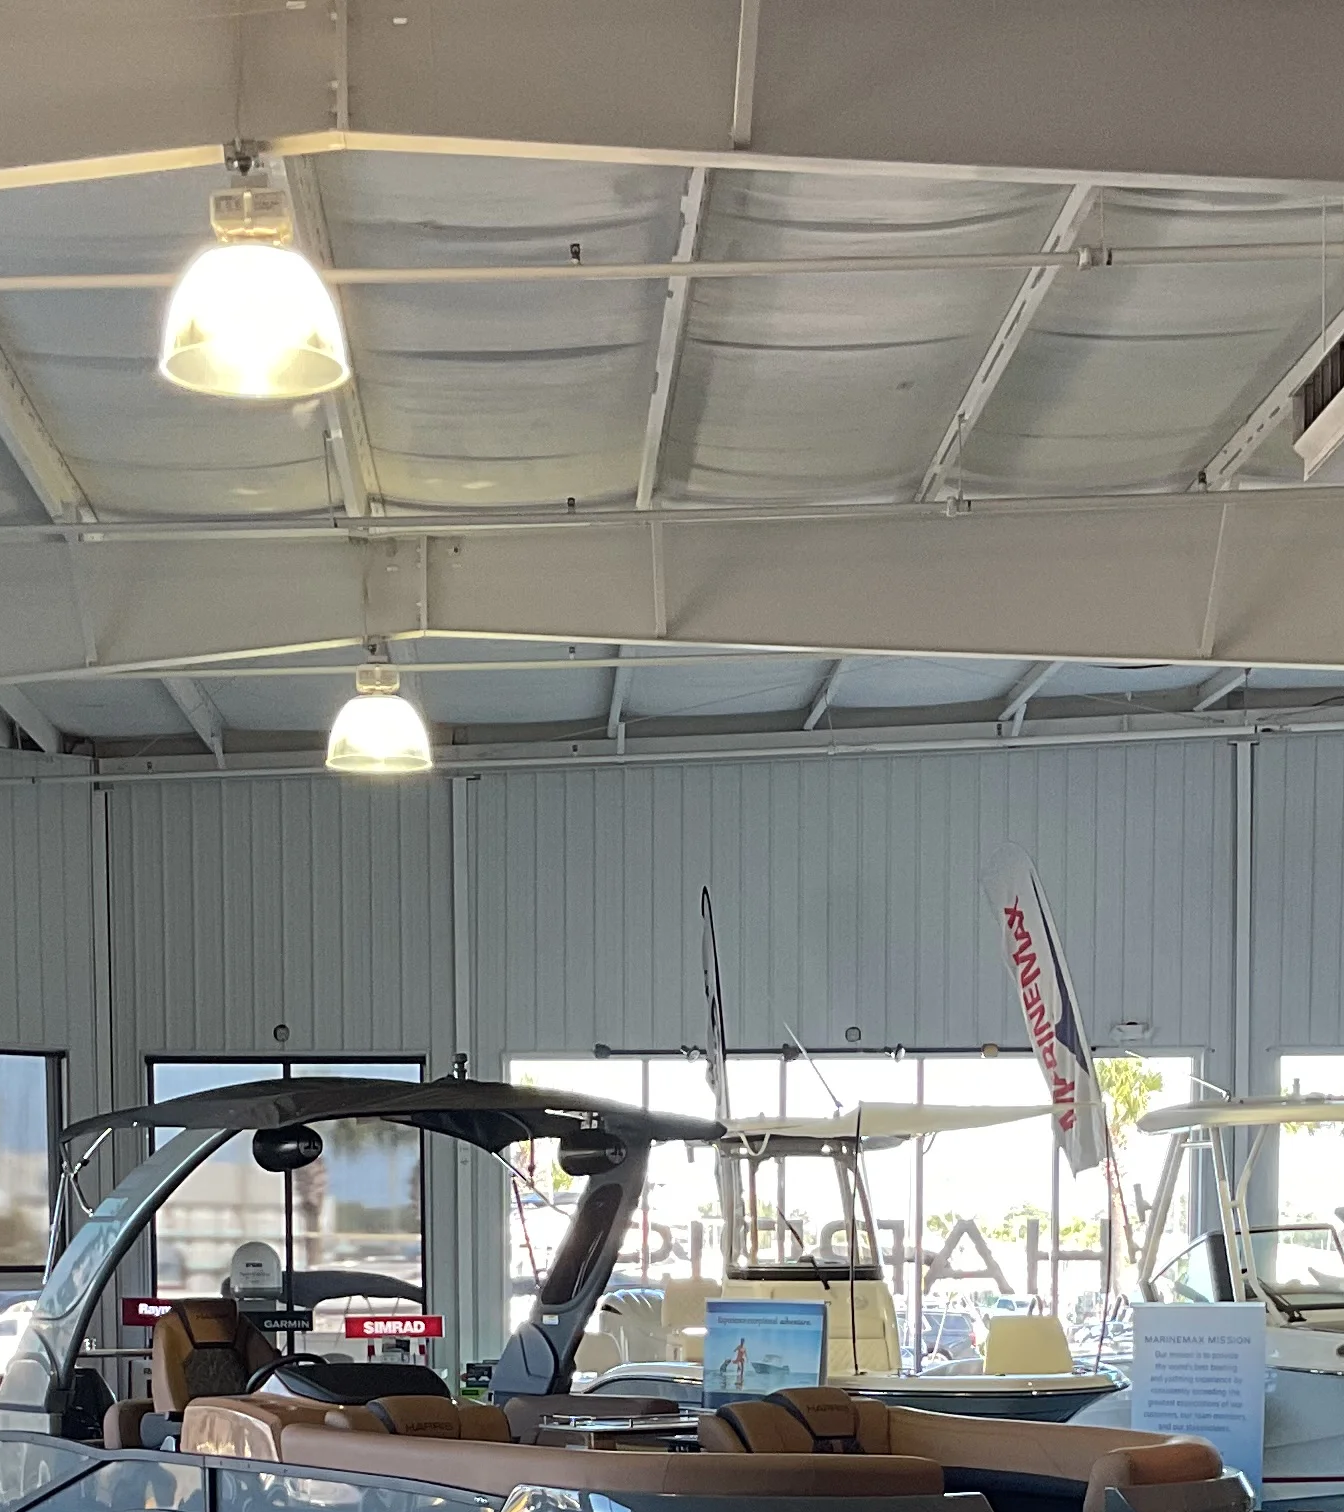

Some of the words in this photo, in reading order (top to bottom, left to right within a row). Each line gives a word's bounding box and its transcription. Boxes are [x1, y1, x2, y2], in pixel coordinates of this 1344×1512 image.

[1004, 895, 1078, 1133] MRINEMAX
[263, 1319, 310, 1329] GARMIN
[363, 1320, 426, 1335] SIMRAD
[1144, 1335, 1205, 1344] MARINEMAX
[1207, 1335, 1252, 1345] MISSION
